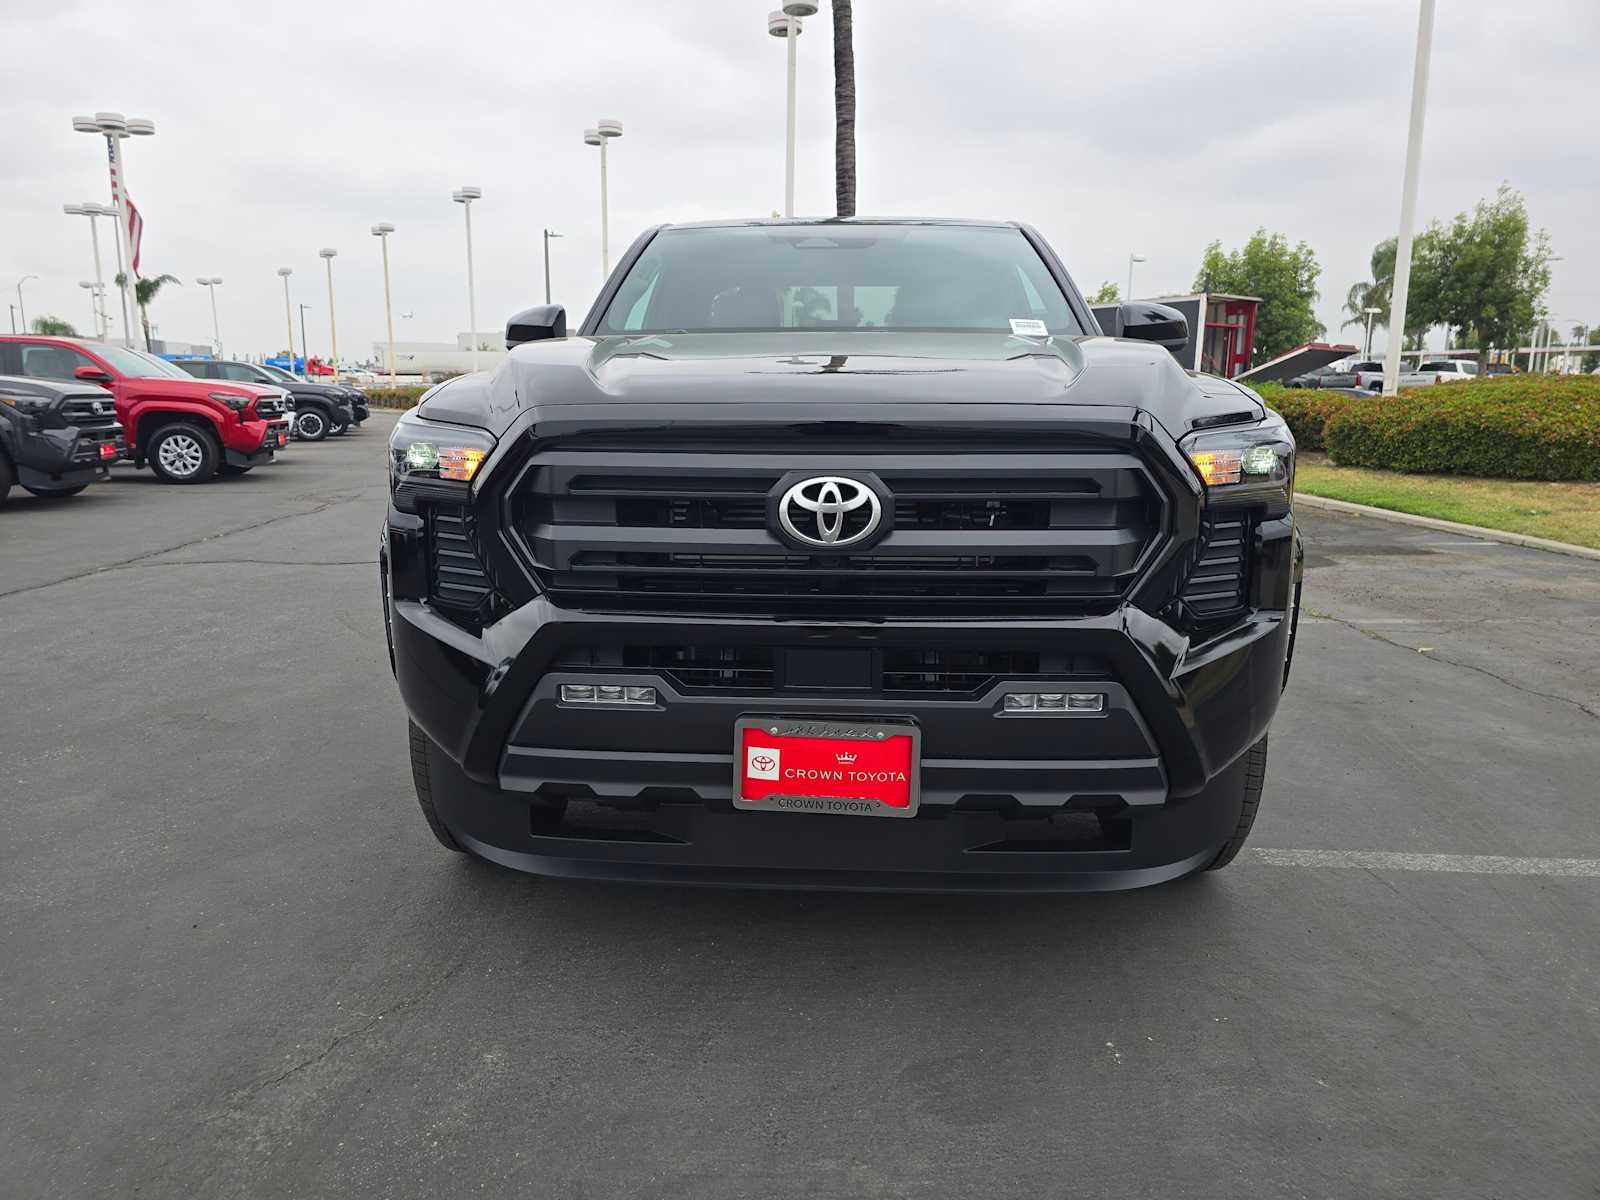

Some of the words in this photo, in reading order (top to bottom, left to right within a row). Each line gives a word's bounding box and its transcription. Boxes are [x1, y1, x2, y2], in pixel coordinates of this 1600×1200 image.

[784, 768, 843, 780] CROWN
[848, 771, 906, 782] TOYOTA
[778, 799, 824, 809] CROWN
[828, 801, 872, 812] TOYOTA
